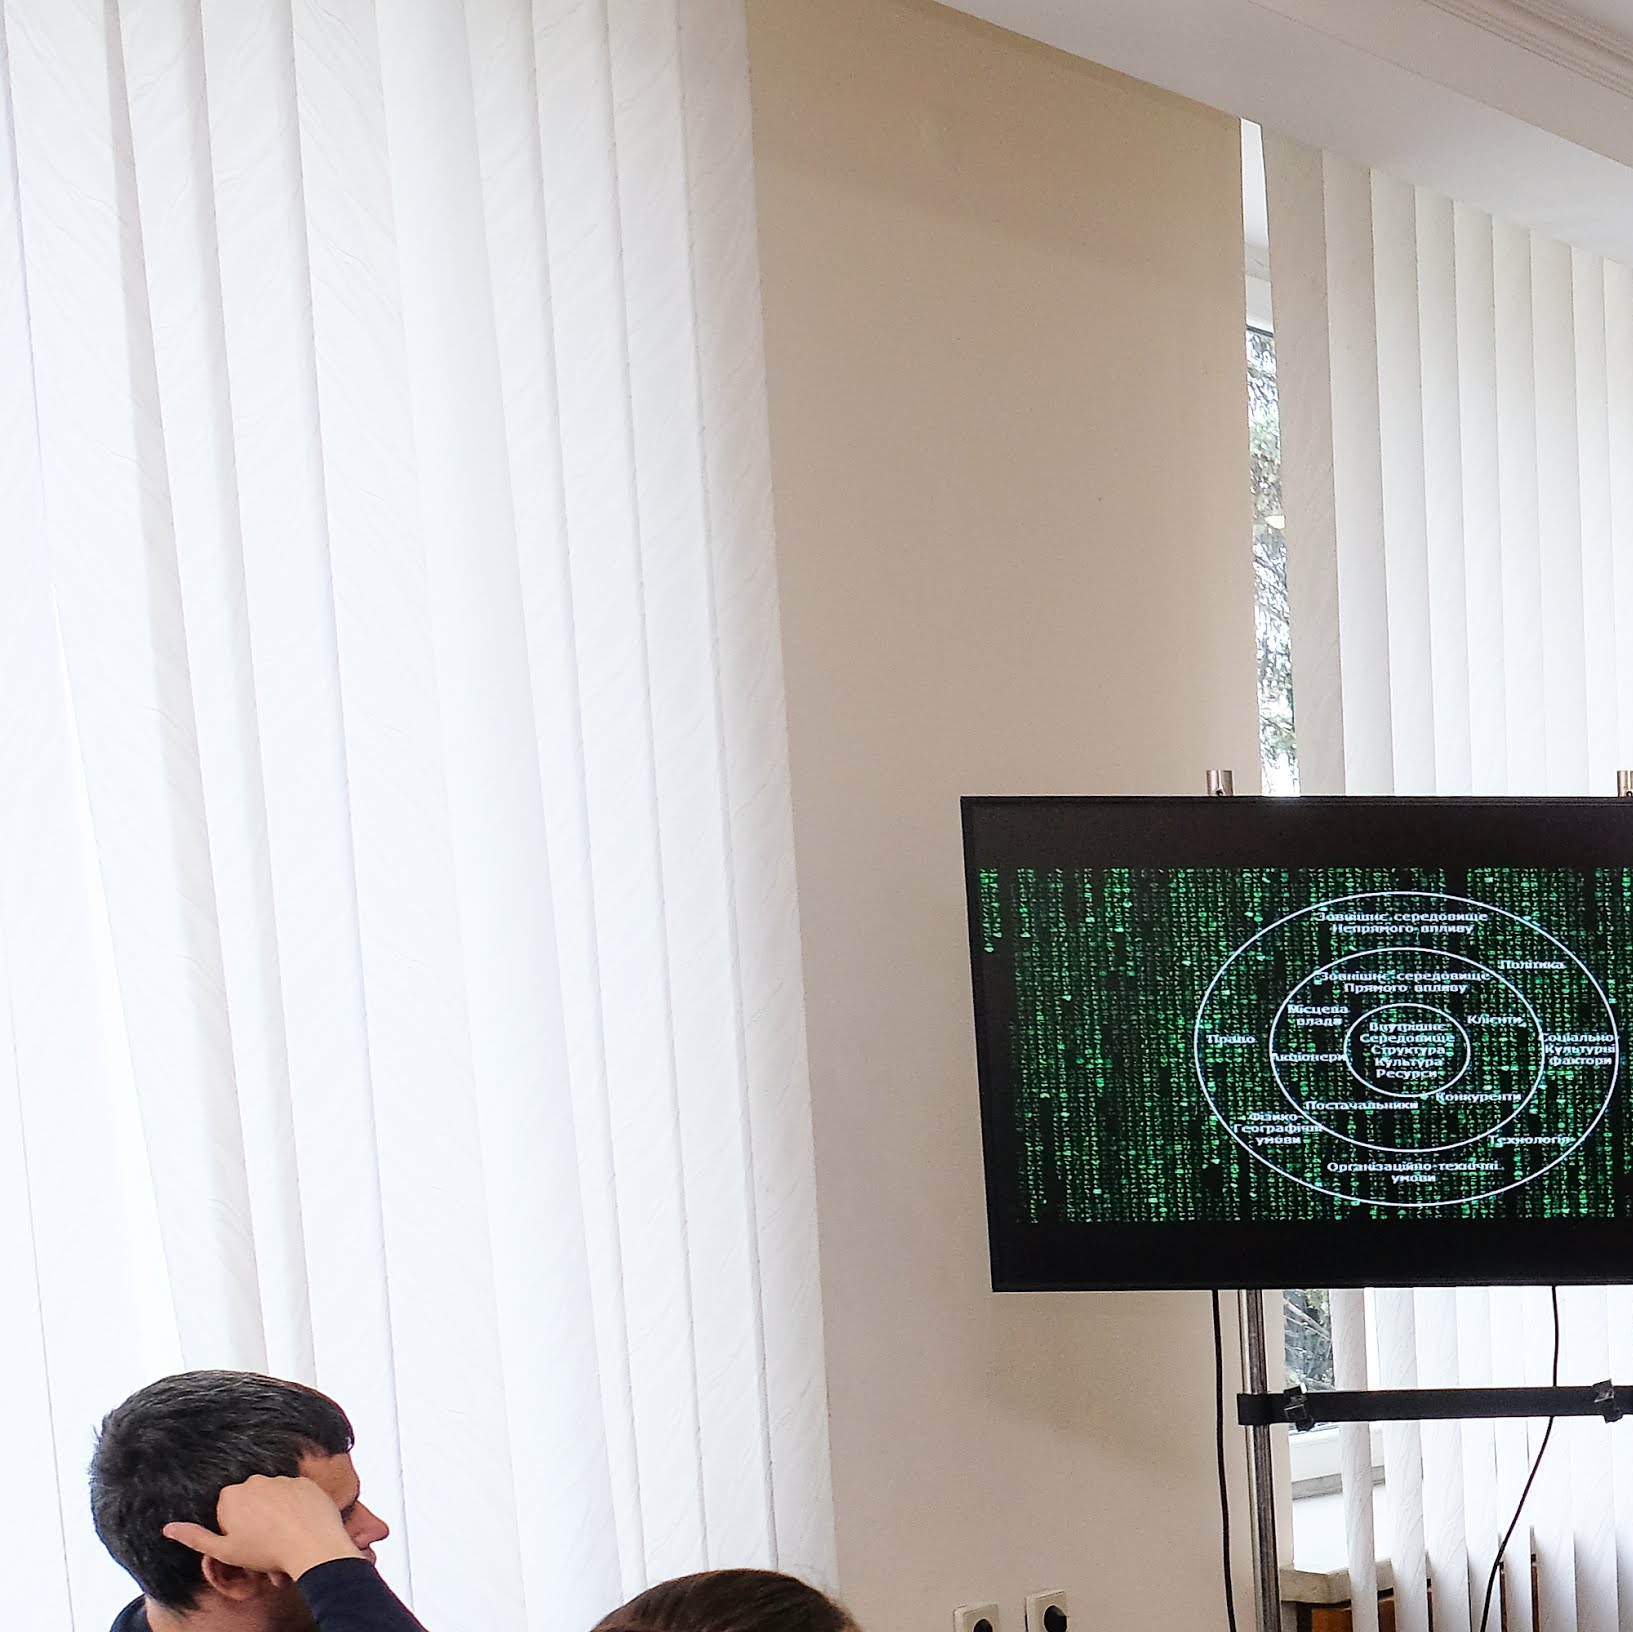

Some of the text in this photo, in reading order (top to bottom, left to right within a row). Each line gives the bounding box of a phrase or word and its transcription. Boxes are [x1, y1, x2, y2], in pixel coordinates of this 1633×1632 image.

[1394, 912, 1488, 923] середовище
[1332, 923, 1474, 934] Непрямого впливу
[1397, 972, 1491, 983] середовище
[1343, 983, 1408, 993] Прямого
[1371, 1045, 1446, 1056] Структура
[1375, 1057, 1443, 1068] Культура
[1549, 1056, 1613, 1066] фактори
[1376, 1069, 1438, 1080] Ресурси
[1436, 1091, 1522, 1102] Конкуренти
[1303, 1100, 1419, 1110] Постачальники
[1256, 1136, 1301, 1147] умови
[1391, 1174, 1436, 1185] умови
